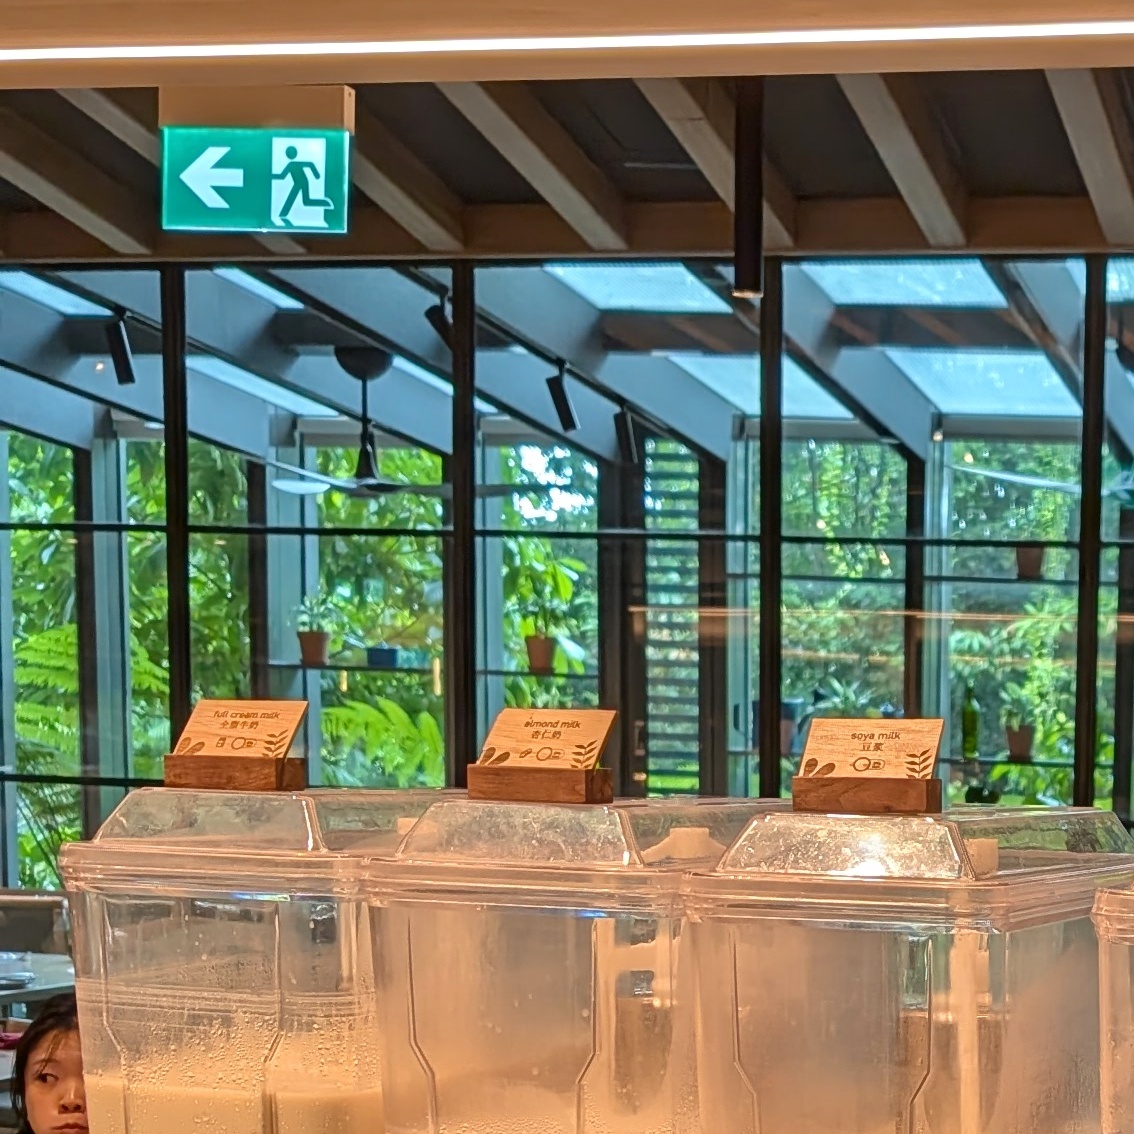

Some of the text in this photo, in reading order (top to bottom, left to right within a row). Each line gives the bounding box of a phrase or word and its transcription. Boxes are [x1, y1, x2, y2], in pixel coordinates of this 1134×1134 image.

[213, 710, 281, 719] full cream milk
[523, 720, 582, 729] almond milk
[850, 731, 901, 741] soya milk
